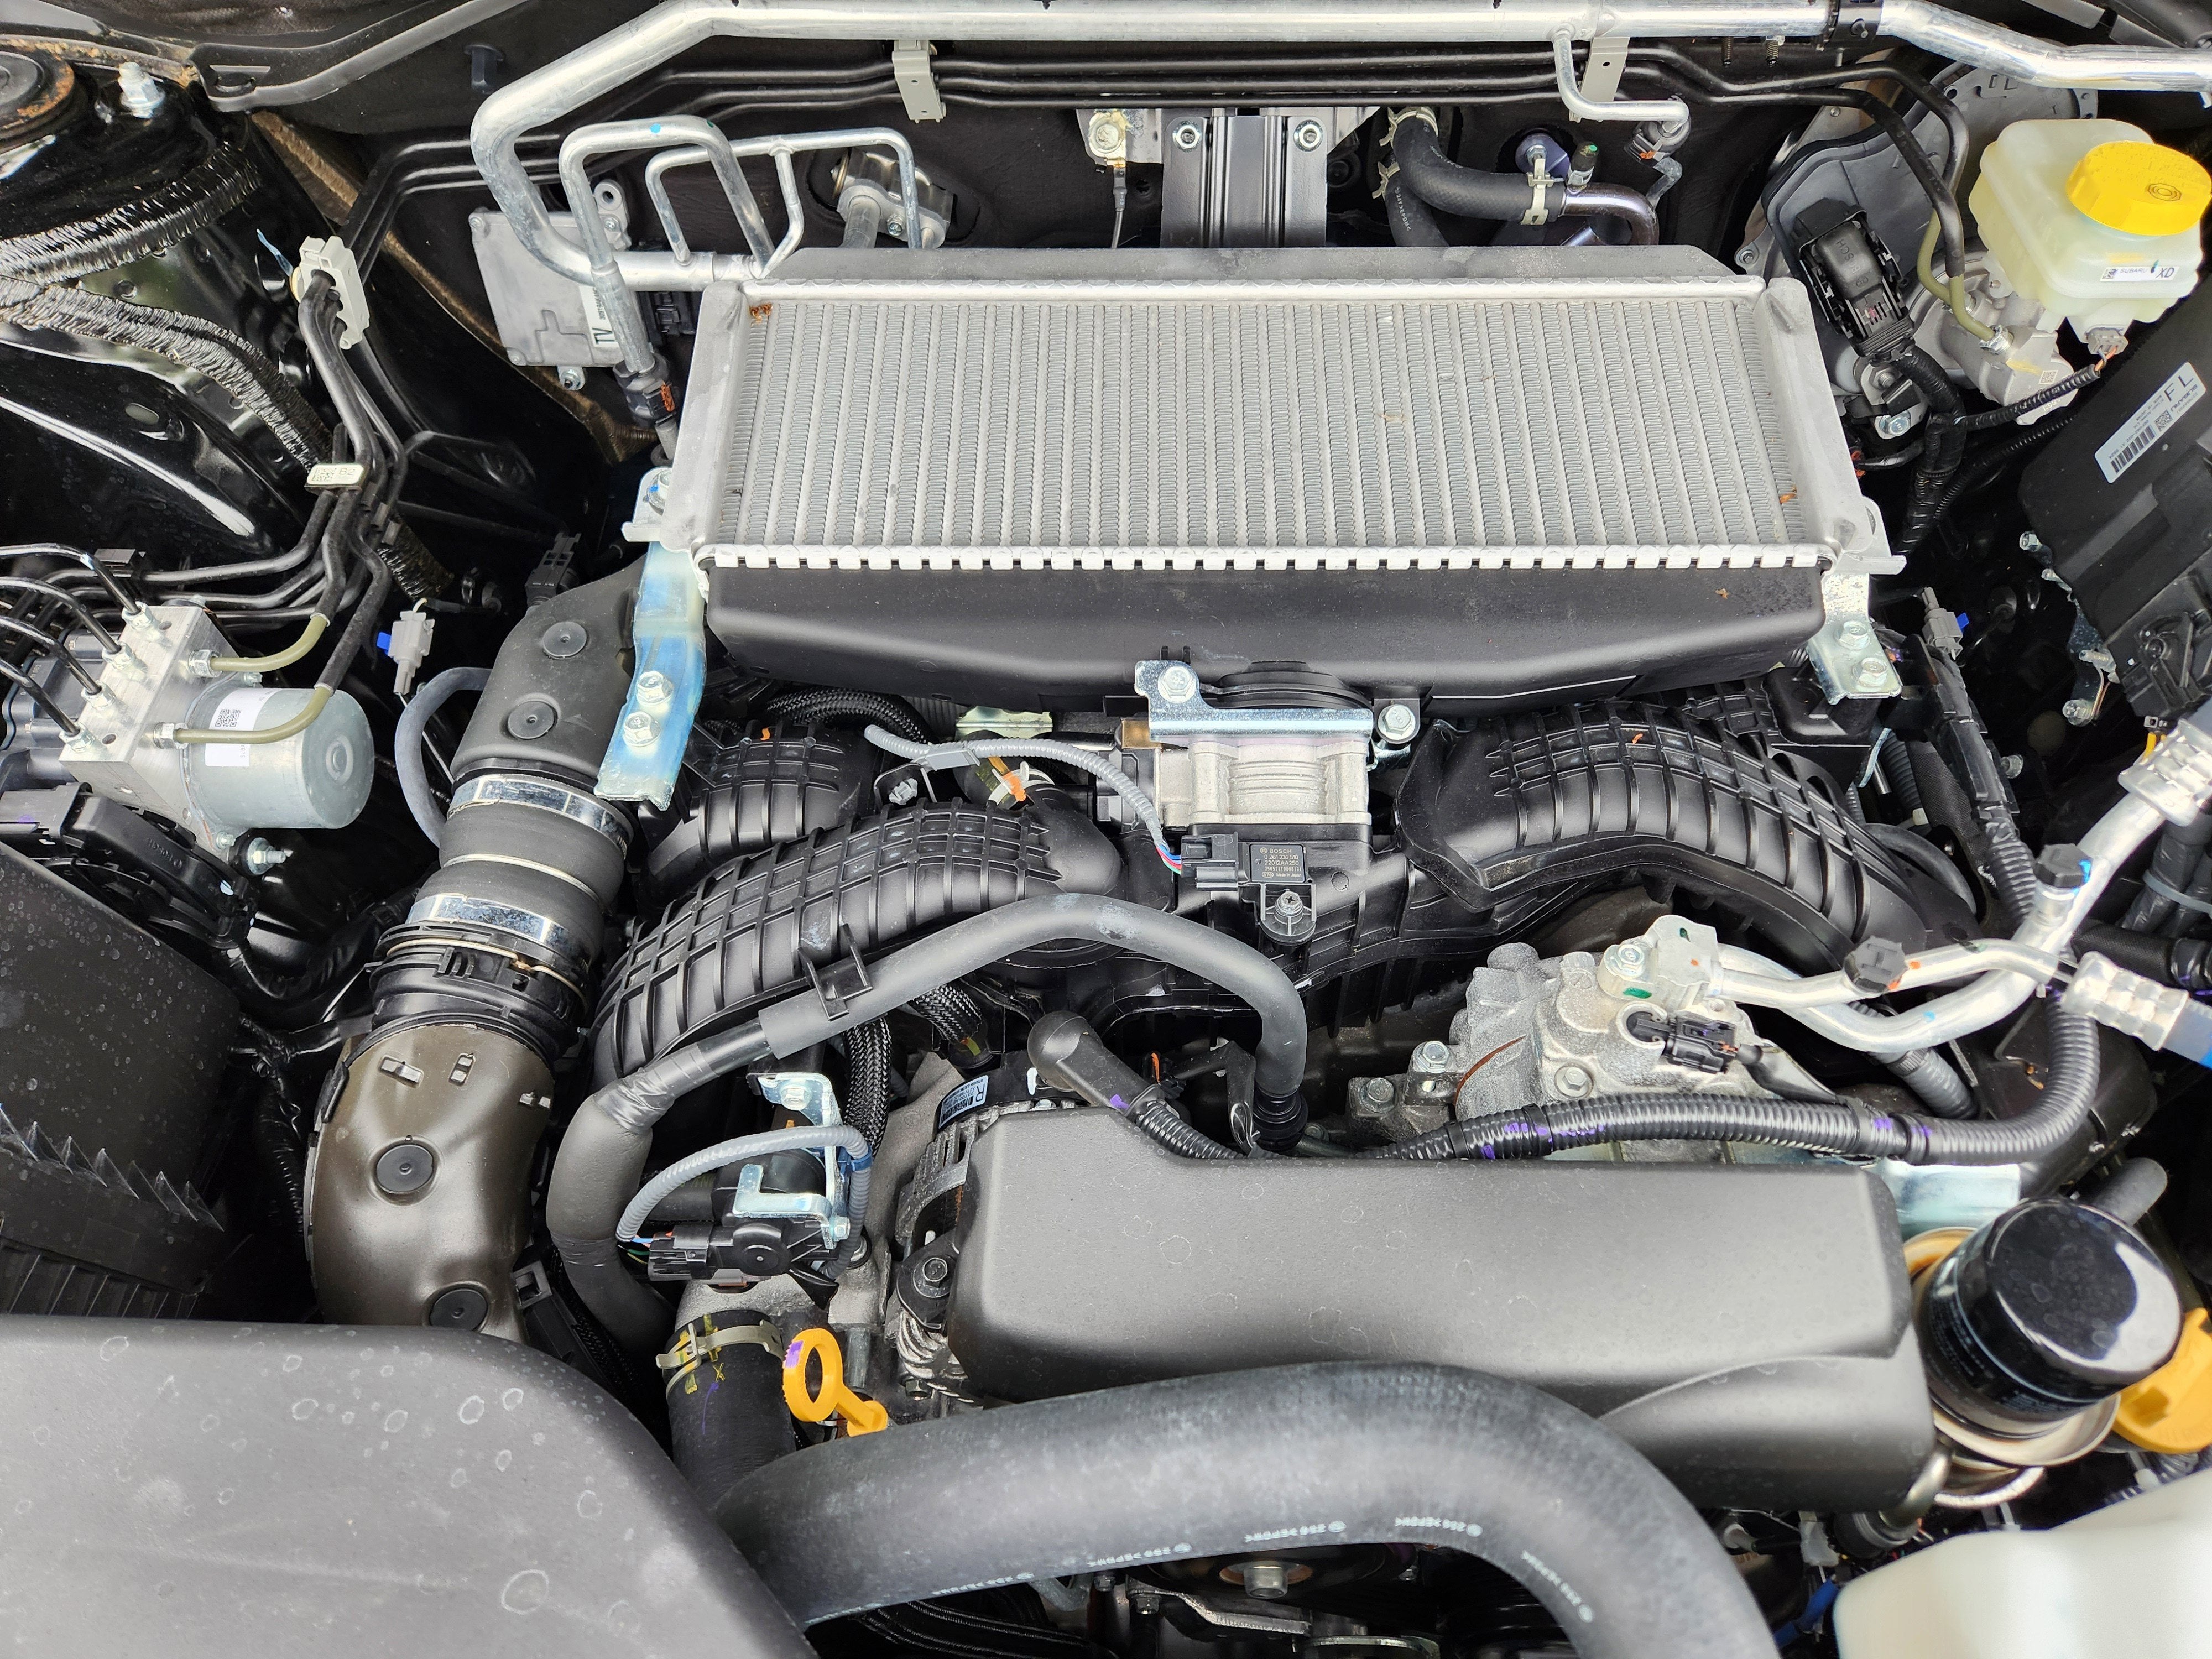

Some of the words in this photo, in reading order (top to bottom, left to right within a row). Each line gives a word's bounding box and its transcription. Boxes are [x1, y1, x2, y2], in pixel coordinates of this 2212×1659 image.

[1836, 239, 1861, 273] BOSCH
[2156, 267, 2174, 278] XD
[592, 327, 615, 345] TV
[2171, 384, 2198, 411] SUBARU
[976, 1084, 985, 1102] R
